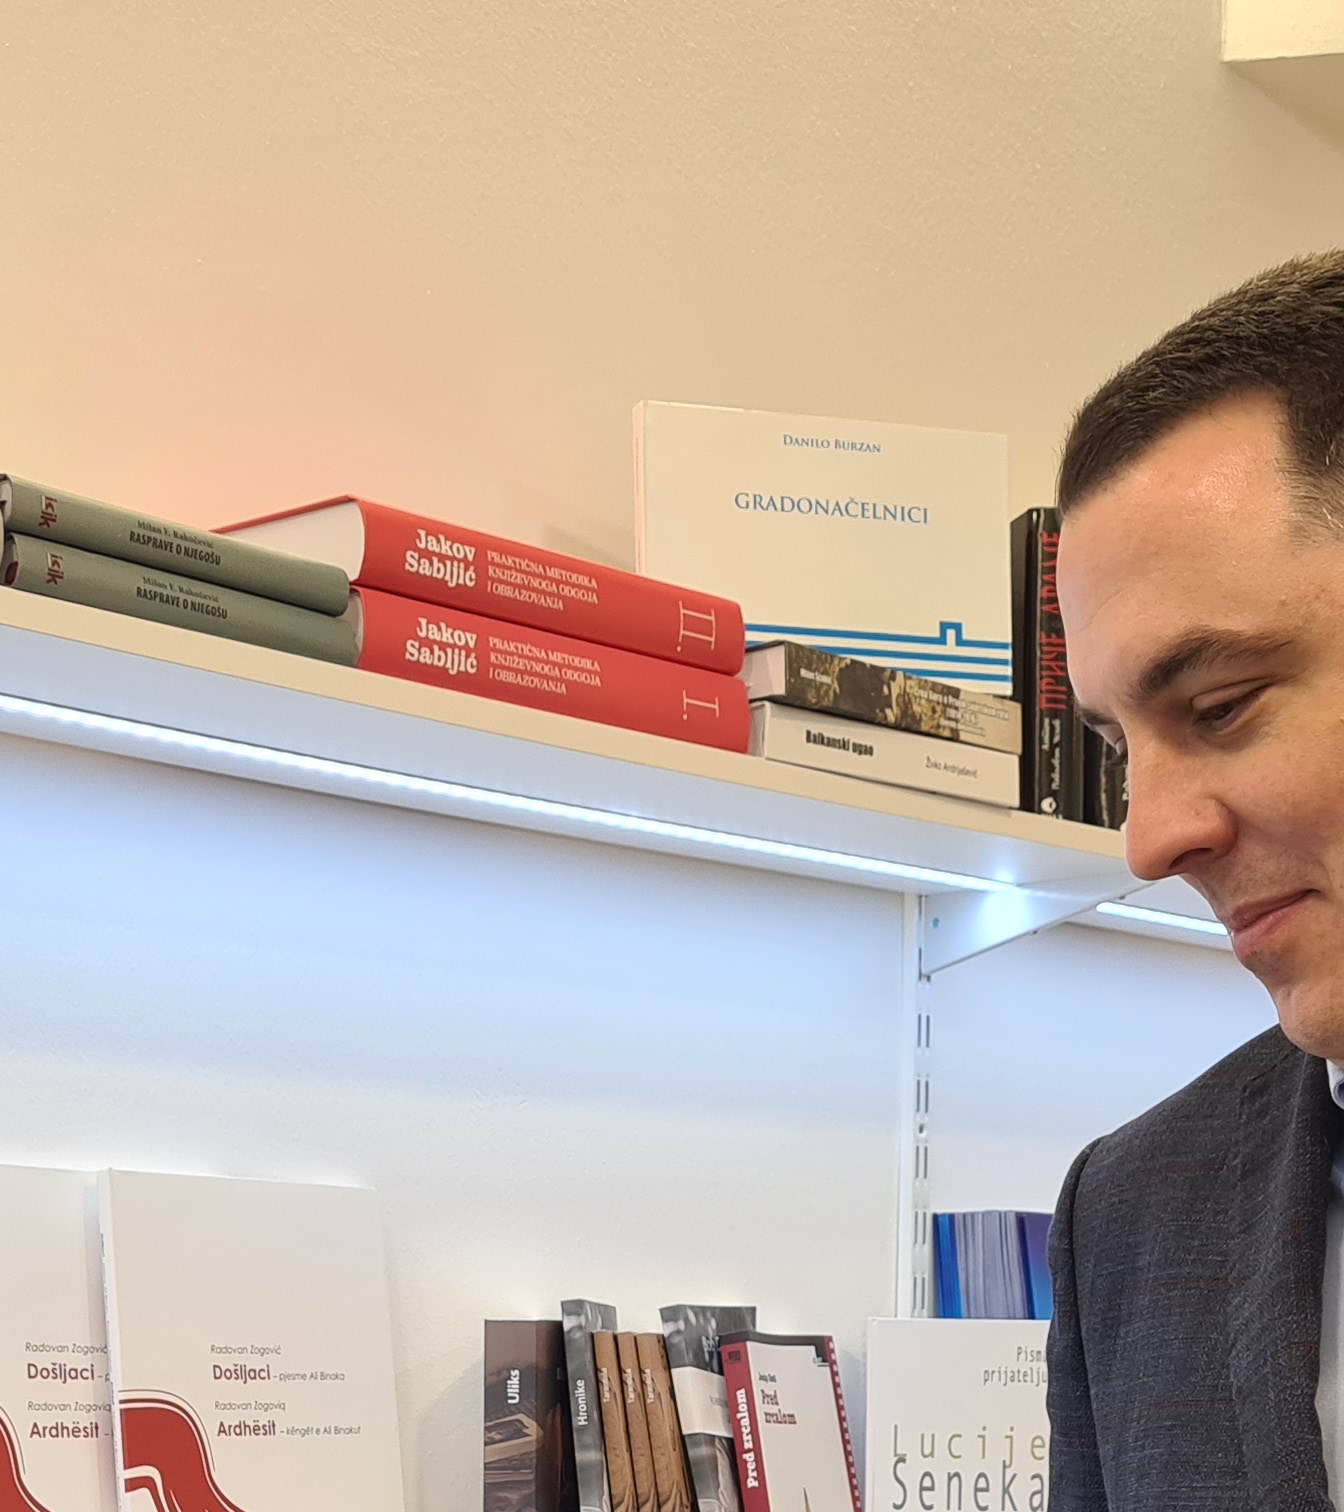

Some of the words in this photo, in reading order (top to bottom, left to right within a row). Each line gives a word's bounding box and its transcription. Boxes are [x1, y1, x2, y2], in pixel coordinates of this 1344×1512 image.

[783, 433, 830, 450] DANILO
[834, 438, 881, 454] BURZAN
[734, 492, 929, 524] GRADONAČELNICI
[130, 531, 174, 554] RASPRAVE
[176, 543, 182, 555] O
[183, 544, 221, 566] NJEGOŠU
[415, 528, 476, 562] Jakov
[404, 550, 477, 588] Sabljić
[488, 564, 557, 595] KNJIŽEVNOGA
[559, 585, 598, 605] ODGOJA
[416, 618, 478, 649] Jakov
[404, 639, 478, 675] Sabljić
[805, 729, 850, 753] Balkanski
[852, 739, 874, 757] ugao
[210, 1344, 247, 1355] Radovan
[250, 1344, 282, 1356] Zogović
[27, 1362, 95, 1383] Došljaci
[212, 1364, 272, 1382] Došljaci
[279, 1372, 308, 1383] pjesme
[310, 1372, 318, 1381] Ali
[320, 1372, 345, 1381] Binaka
[507, 1369, 520, 1404] Uliks
[214, 1401, 248, 1411] Radovan
[575, 1379, 588, 1426] Hronike
[29, 1420, 100, 1439] Ardhësit
[735, 1388, 757, 1459] zrcalom
[892, 1424, 1046, 1469] Lucije
[745, 1461, 758, 1488] Pred
[892, 1456, 1046, 1512] Seneka
